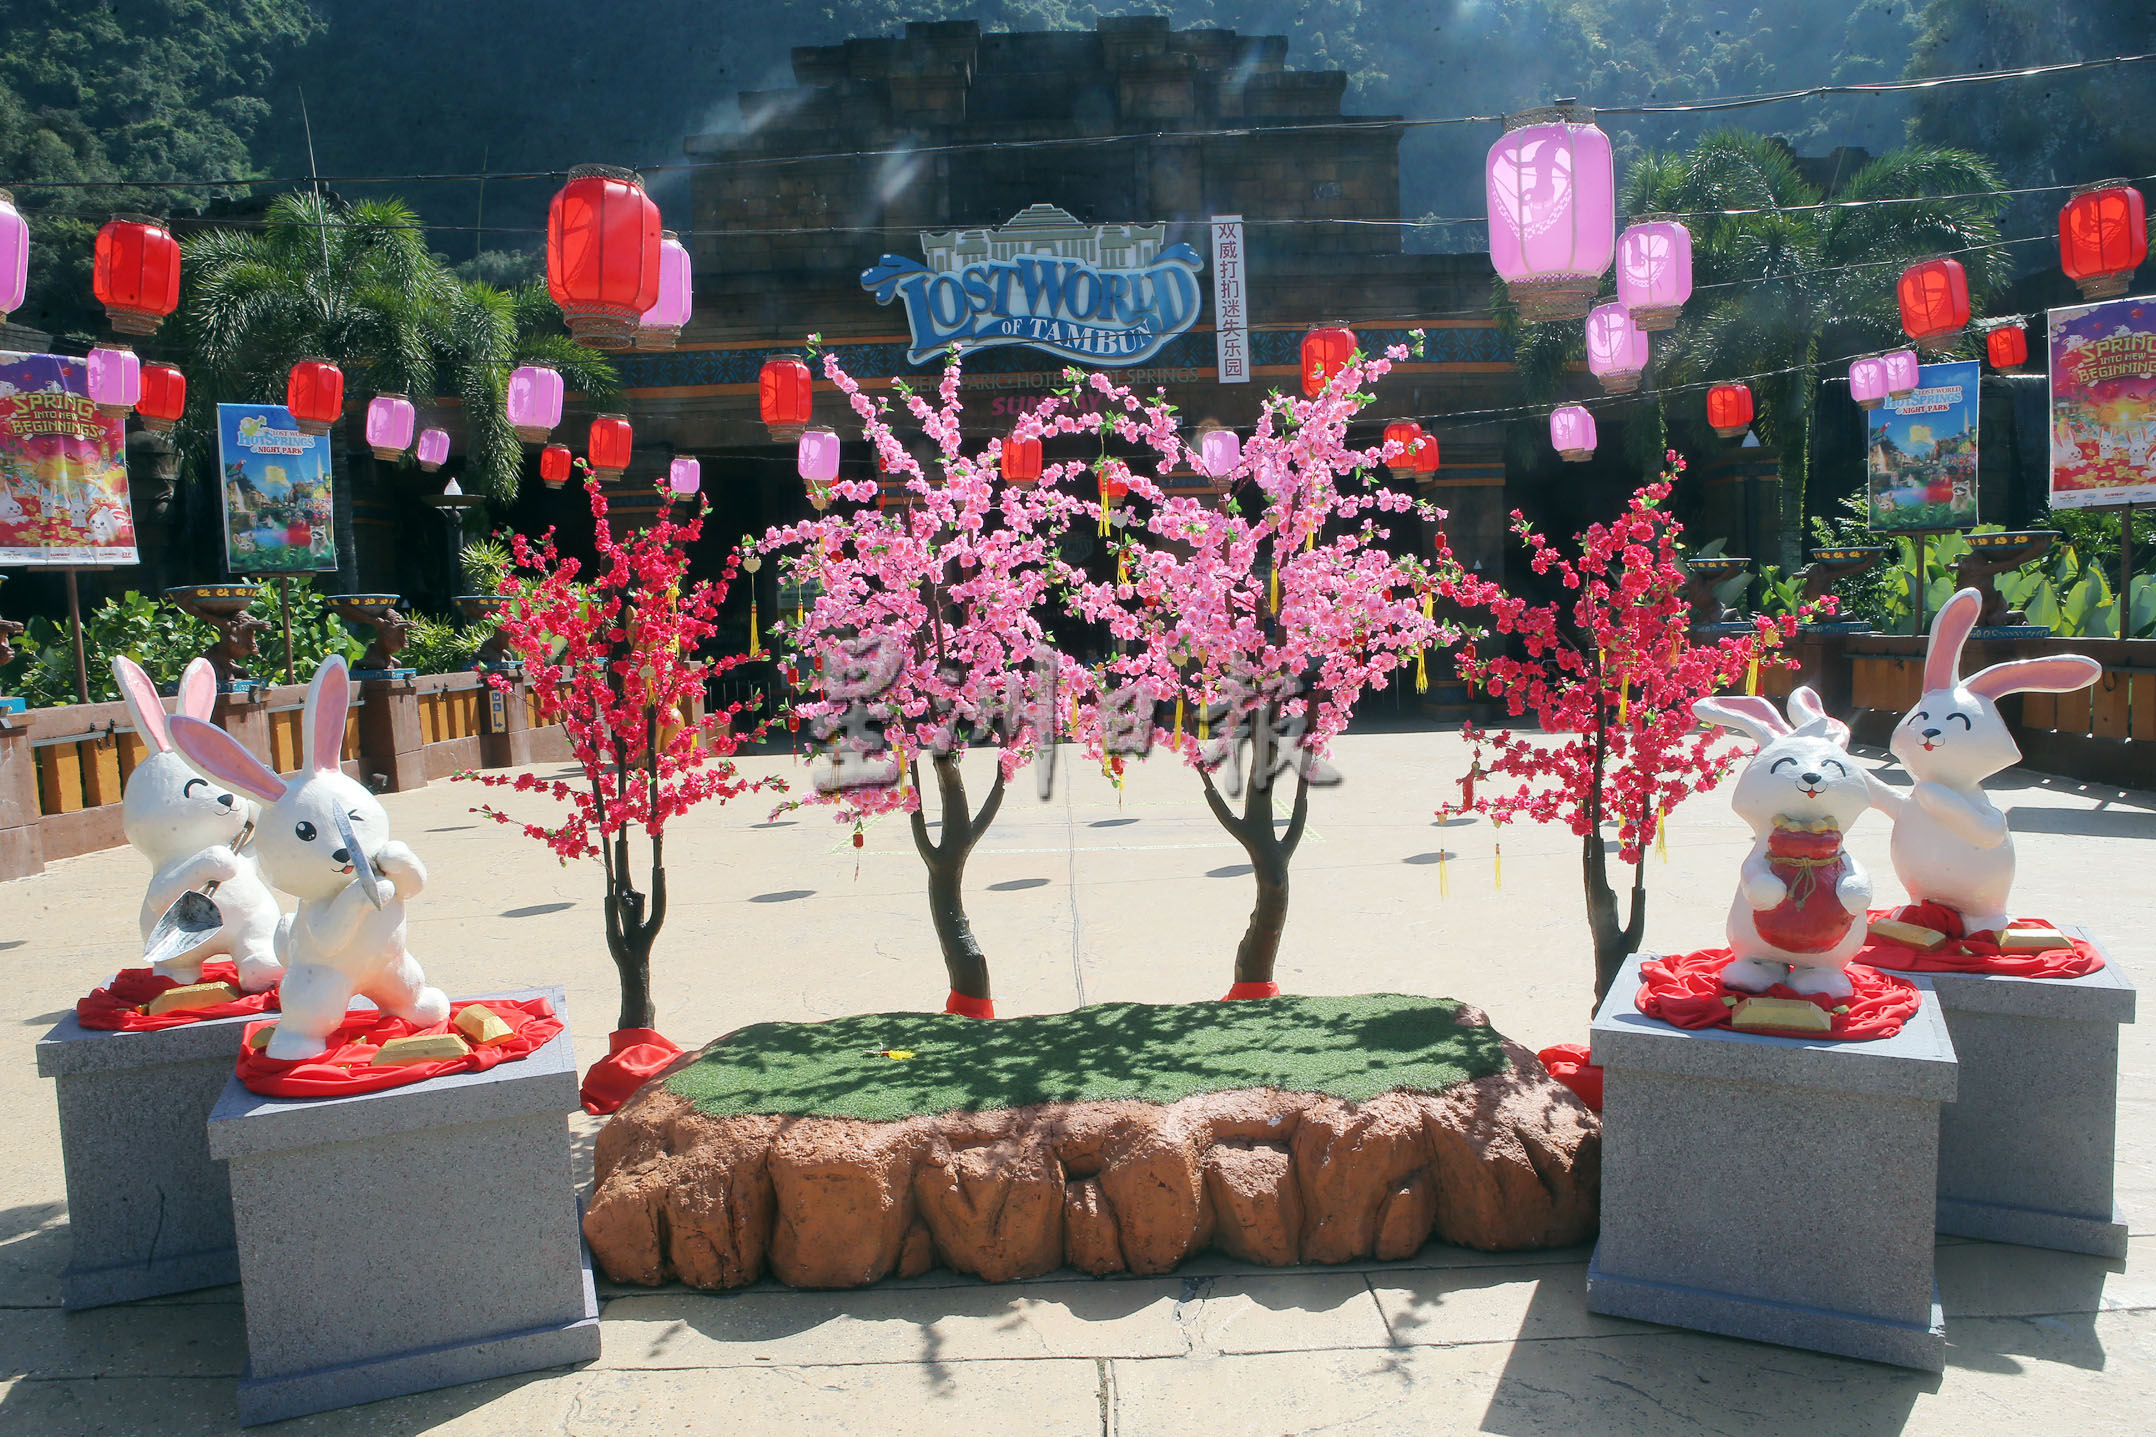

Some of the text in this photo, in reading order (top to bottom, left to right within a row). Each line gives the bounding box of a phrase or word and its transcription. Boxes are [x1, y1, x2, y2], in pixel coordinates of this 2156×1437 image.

[901, 257, 1193, 356] LOST WORLD
[1218, 223, 1243, 377] 双威打扪迷失乐园
[1001, 318, 1153, 355] OF TAMBUN
[2100, 352, 2146, 365] INTO NEW
[1127, 367, 1199, 384] SPRINGS
[11, 394, 95, 419] SPRING
[33, 410, 57, 419] INTO
[1902, 404, 1949, 414] NIGHT PARK
[11, 420, 99, 438] BEGINNINGS
